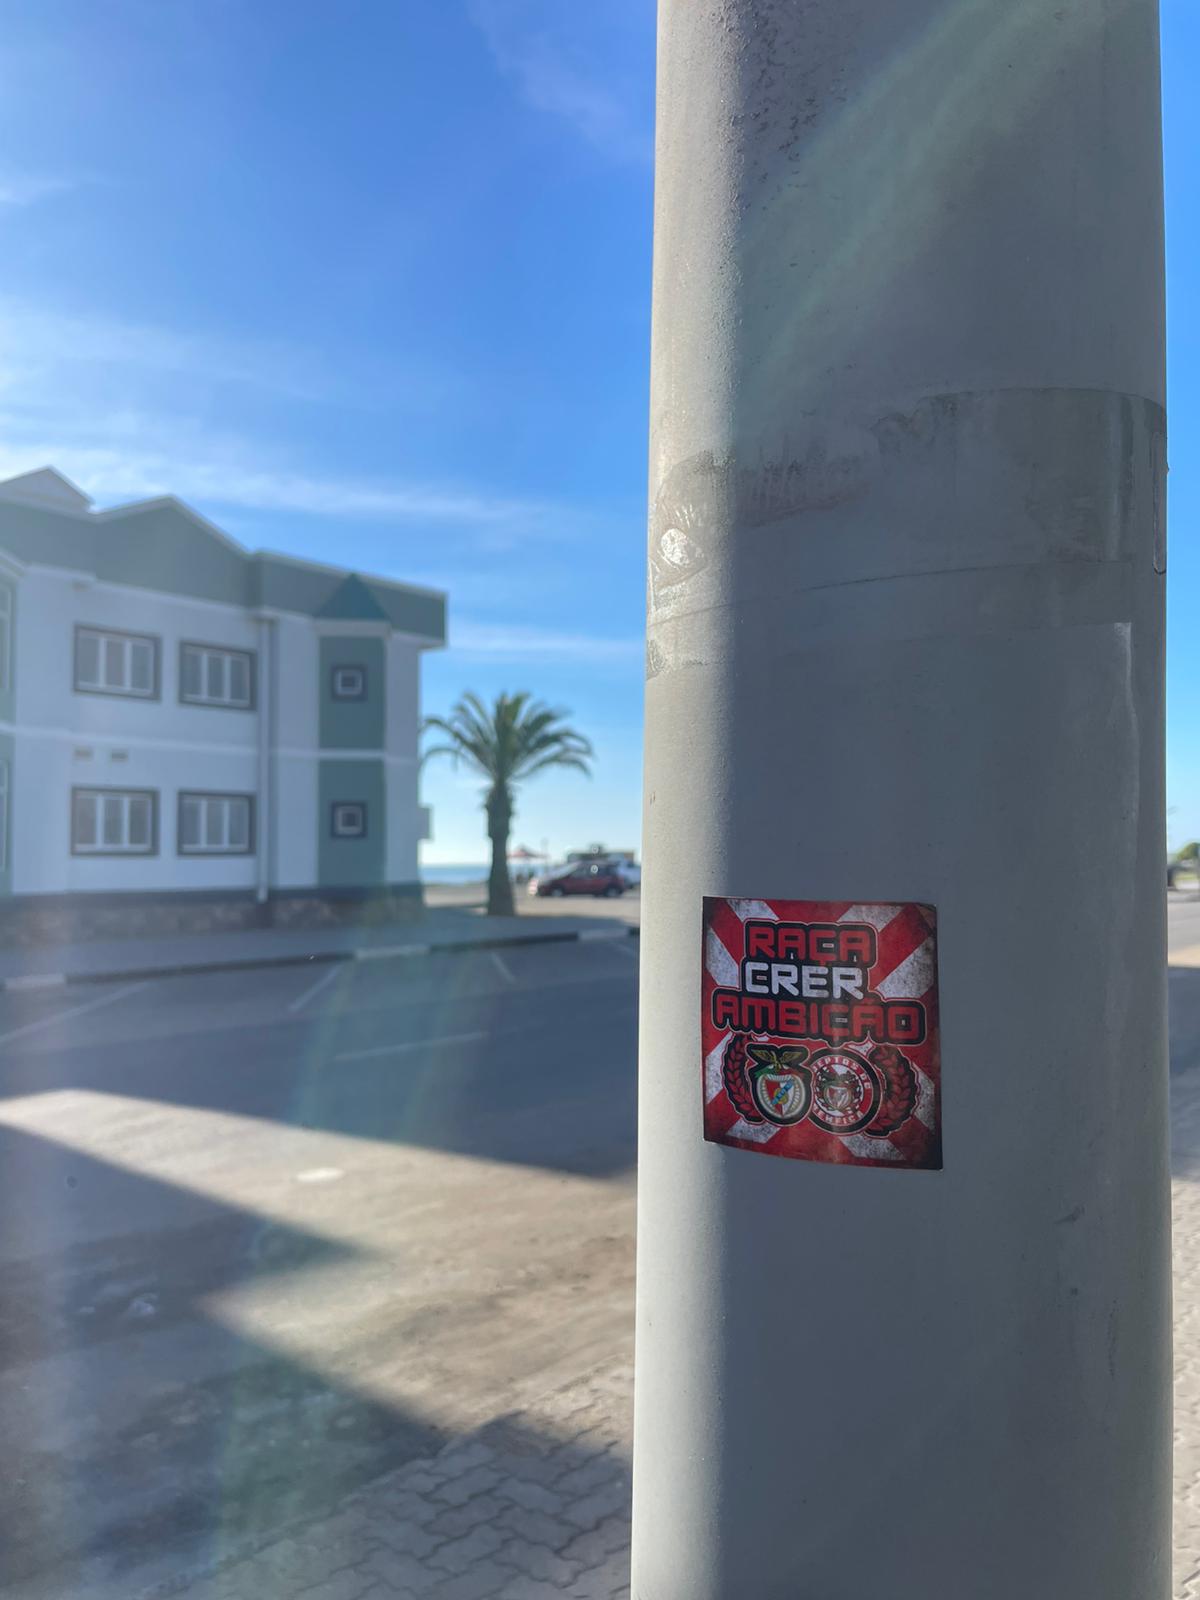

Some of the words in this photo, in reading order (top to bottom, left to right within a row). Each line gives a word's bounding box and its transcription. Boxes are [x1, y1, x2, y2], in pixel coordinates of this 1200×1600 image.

[748, 927, 870, 968] RAÇA
[745, 961, 864, 1000] CRER
[716, 994, 920, 1042] AMBIÇÃO
